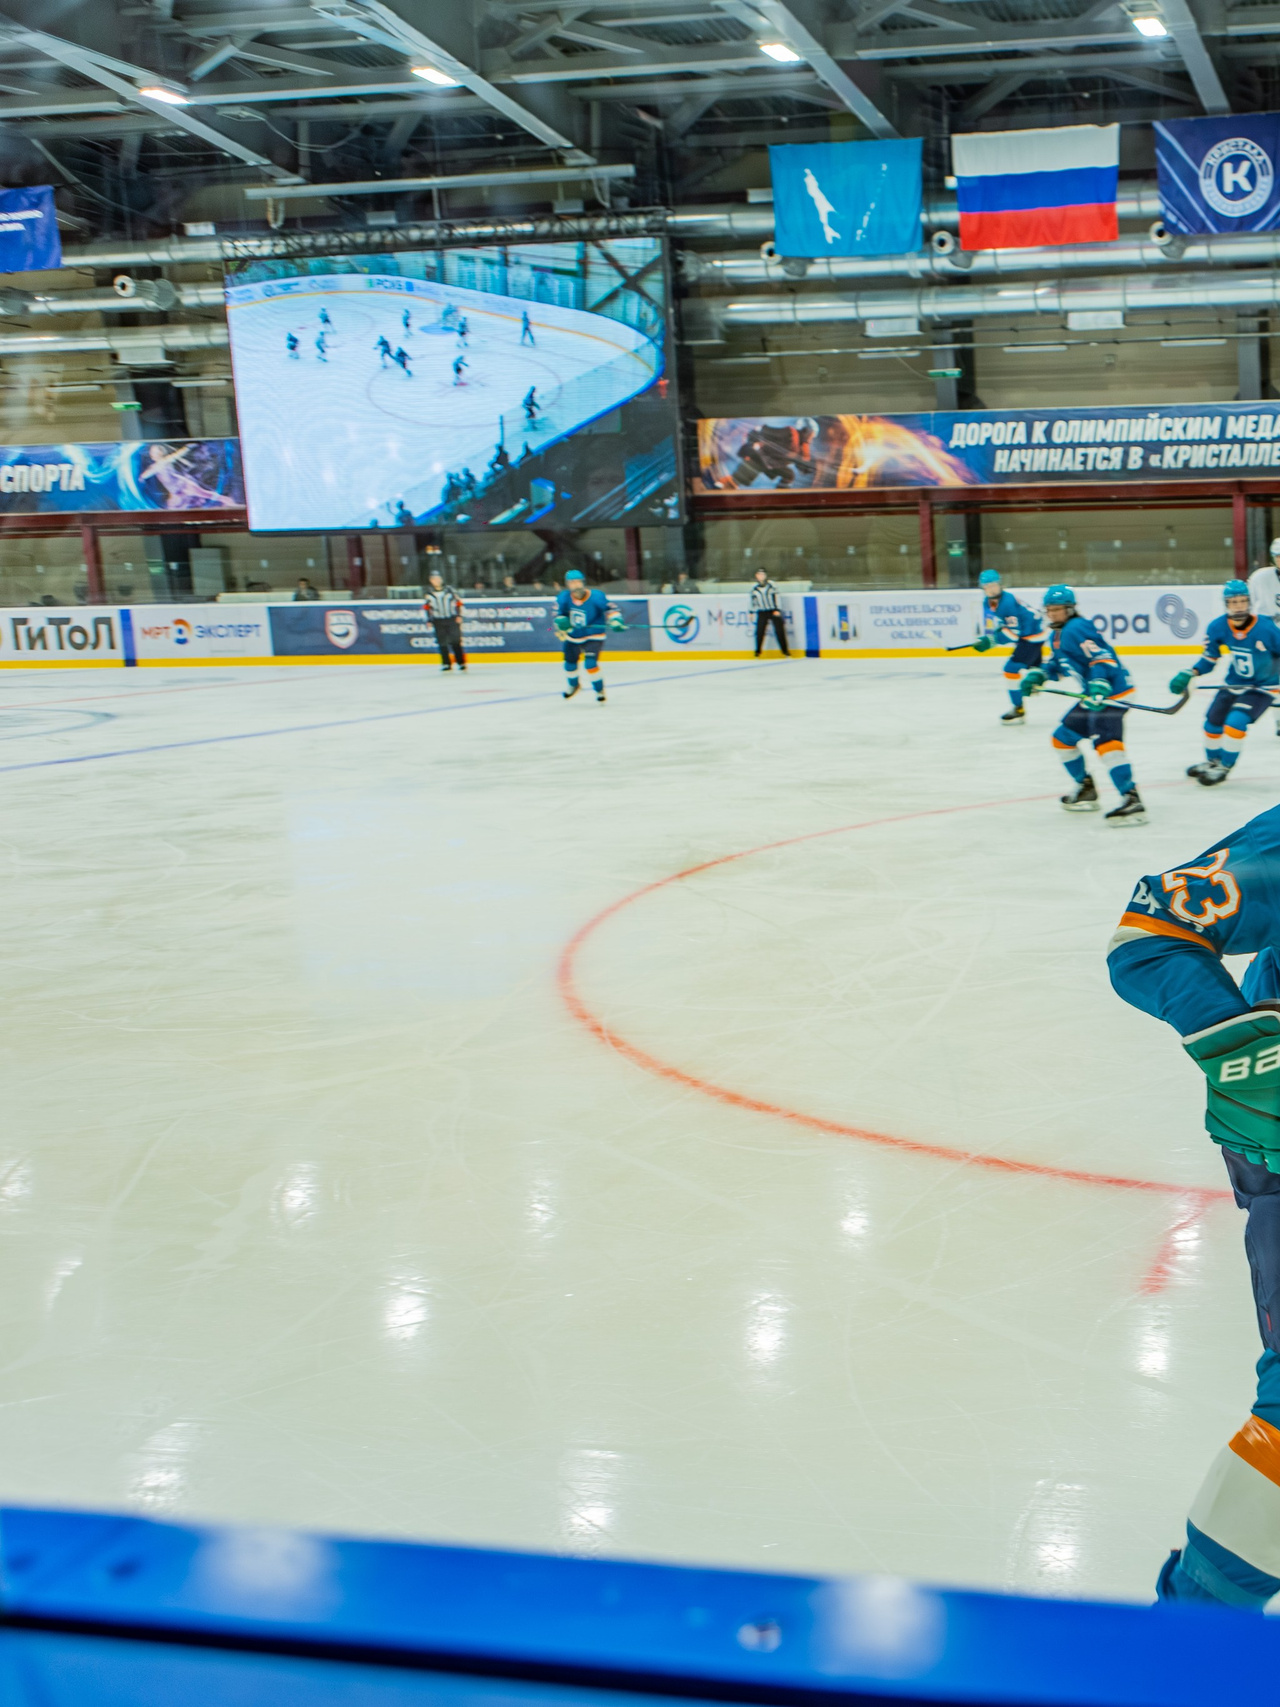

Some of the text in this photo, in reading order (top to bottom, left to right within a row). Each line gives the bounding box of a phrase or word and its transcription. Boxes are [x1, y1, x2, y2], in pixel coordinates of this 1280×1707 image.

[949, 421, 1027, 449] ДОРОГА
[1031, 421, 1047, 445] К
[1051, 413, 1222, 444] ОЛИМПИЙСКИМ
[993, 446, 1125, 473] НАЧИНАЕТСЯ
[1127, 446, 1144, 470] В
[0, 463, 86, 493] СПОРТА
[869, 603, 962, 615] ПРАВИТЕЛЬСТВО
[195, 624, 261, 639] ЭКСПЕРТ
[1161, 848, 1242, 927] 23
